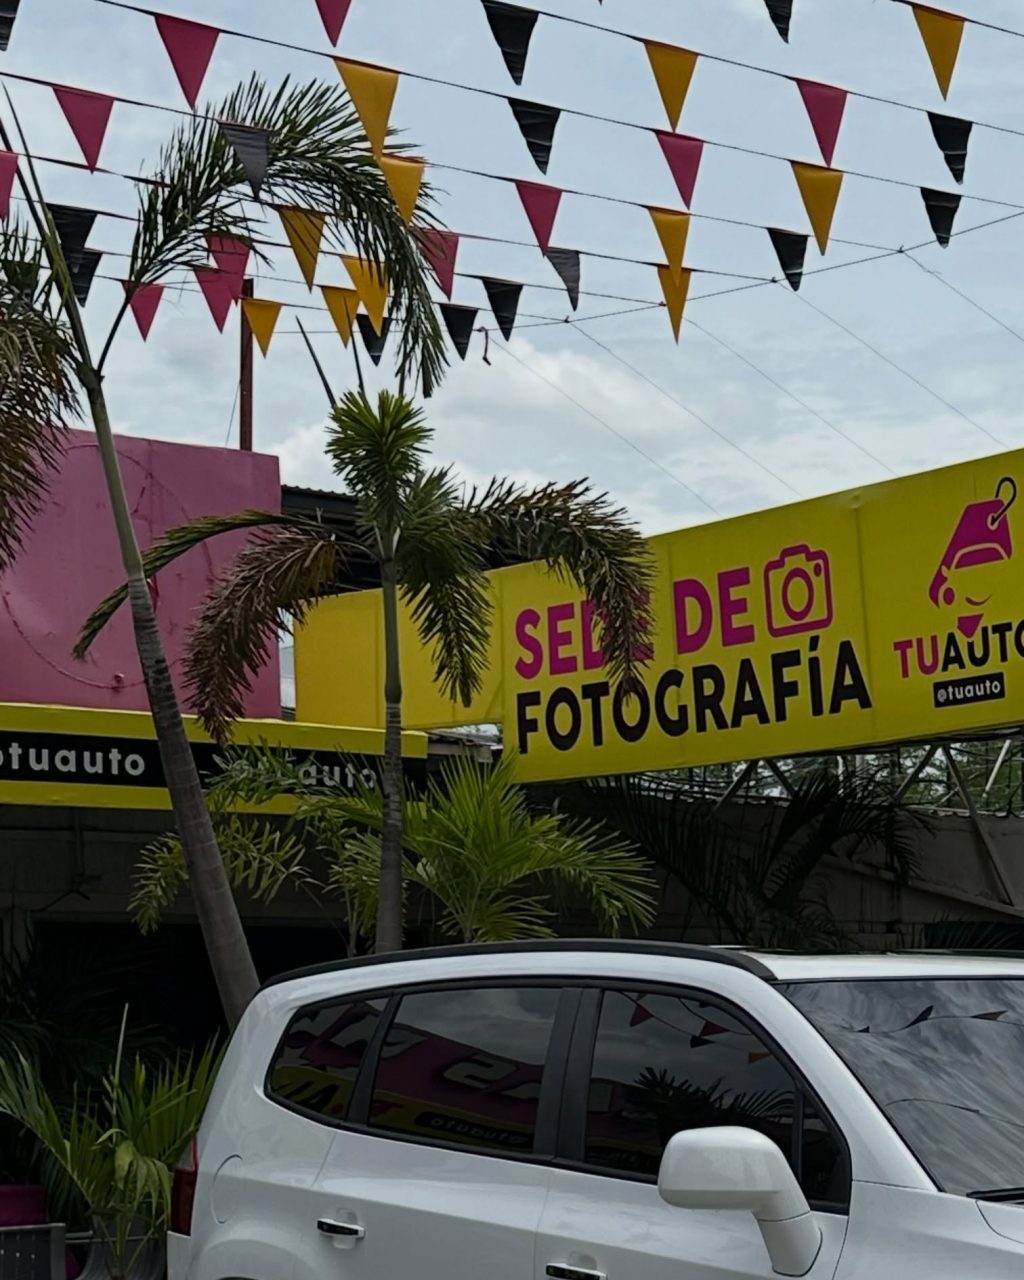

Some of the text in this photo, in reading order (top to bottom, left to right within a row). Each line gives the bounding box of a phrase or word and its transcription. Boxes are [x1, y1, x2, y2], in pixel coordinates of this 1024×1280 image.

[673, 567, 755, 655] DE
[516, 635, 873, 754] FOTOGRAFÍA
[937, 680, 1001, 702] @tuauto
